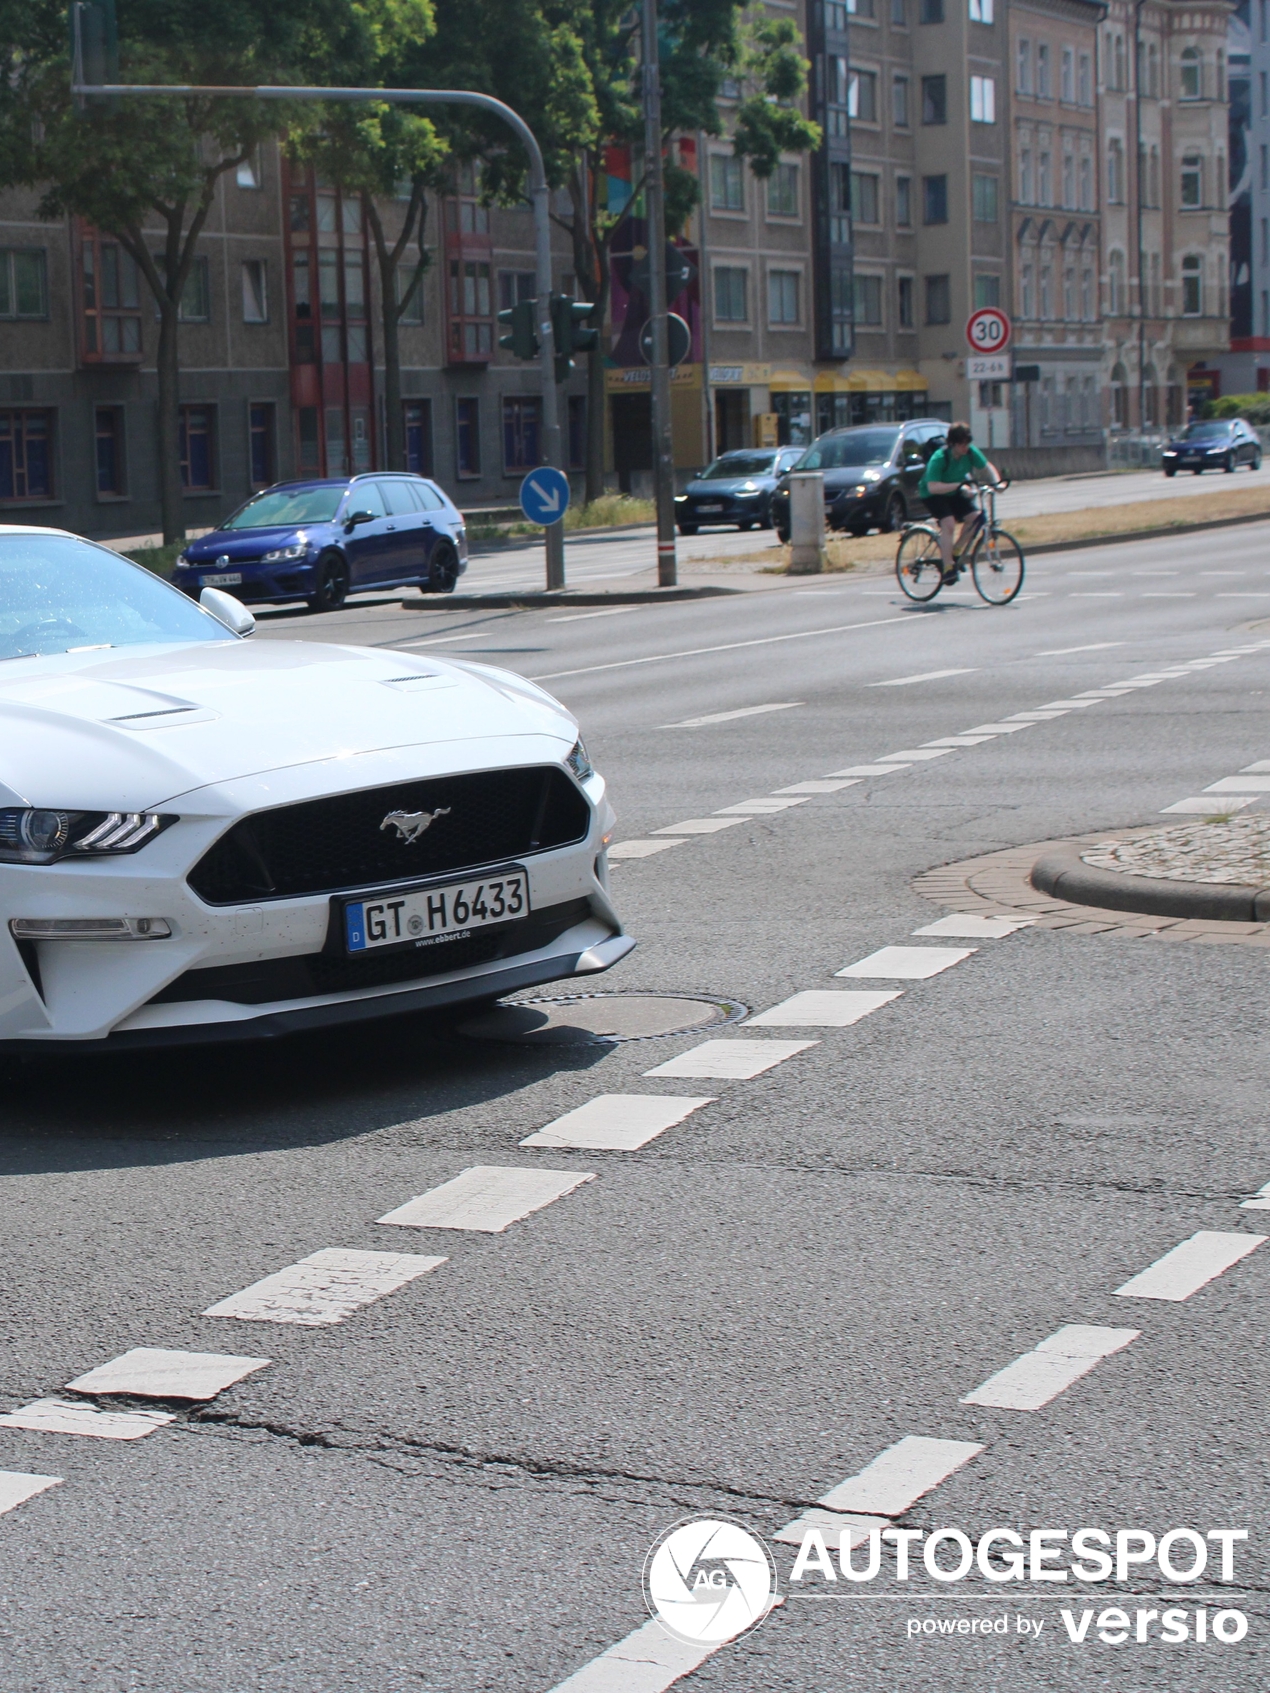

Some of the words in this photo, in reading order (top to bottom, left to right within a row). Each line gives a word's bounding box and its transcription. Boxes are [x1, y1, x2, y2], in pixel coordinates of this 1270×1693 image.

[976, 320, 1000, 341] 30
[366, 900, 406, 942] GT
[352, 931, 360, 943] D
[415, 929, 471, 947] www.ebbert.de
